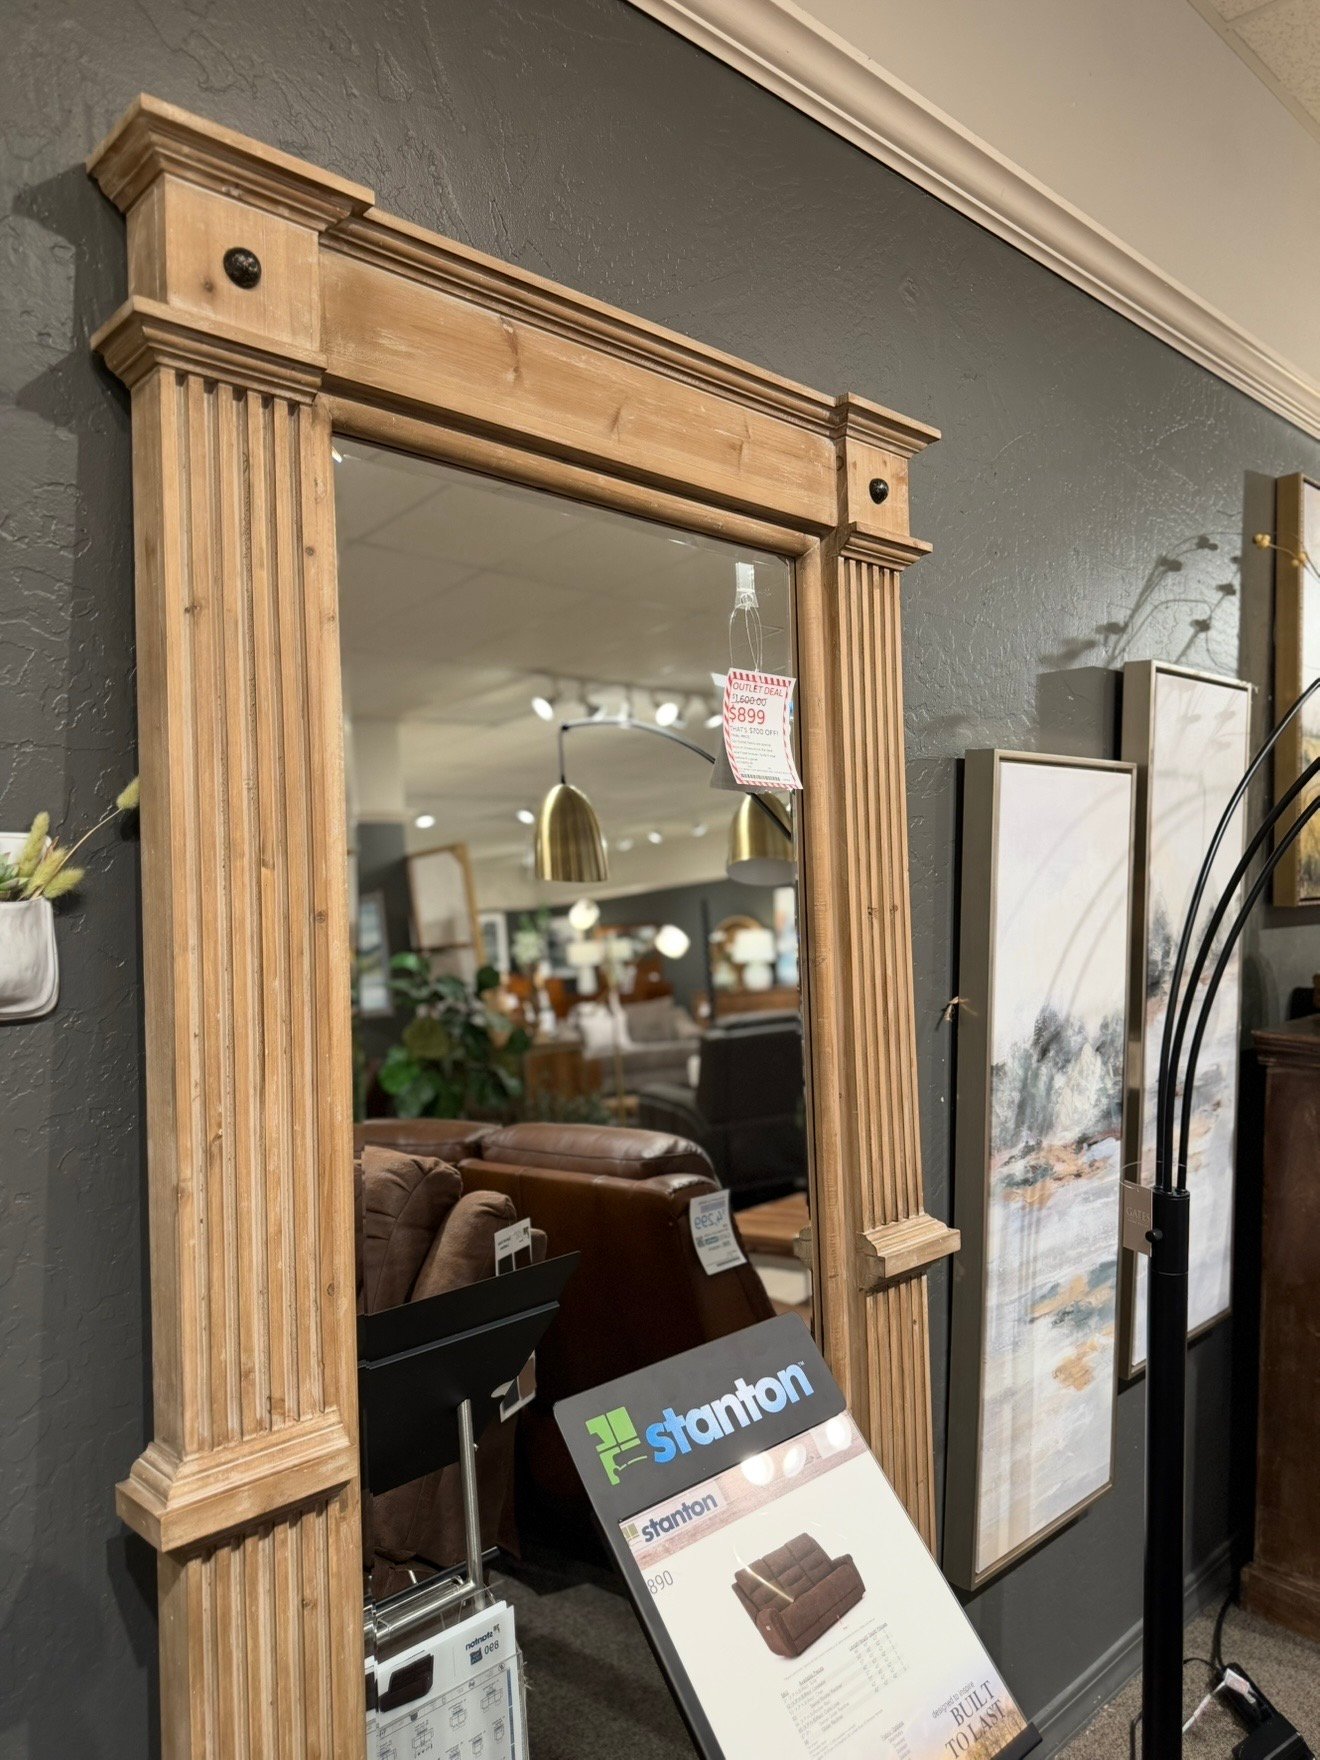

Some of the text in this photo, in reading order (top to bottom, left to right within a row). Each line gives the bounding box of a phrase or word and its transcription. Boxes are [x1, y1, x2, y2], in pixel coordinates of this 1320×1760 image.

[732, 681, 784, 698] OUTLET DEAL
[729, 703, 765, 725] $899
[645, 1363, 815, 1464] stanton
[641, 1493, 719, 1543] stanton
[646, 1569, 674, 1595] 890
[931, 1695, 955, 1719] designed
[949, 1679, 995, 1727] BUILT
[944, 1731, 970, 1759] TO
[967, 1698, 1006, 1742] LAST
